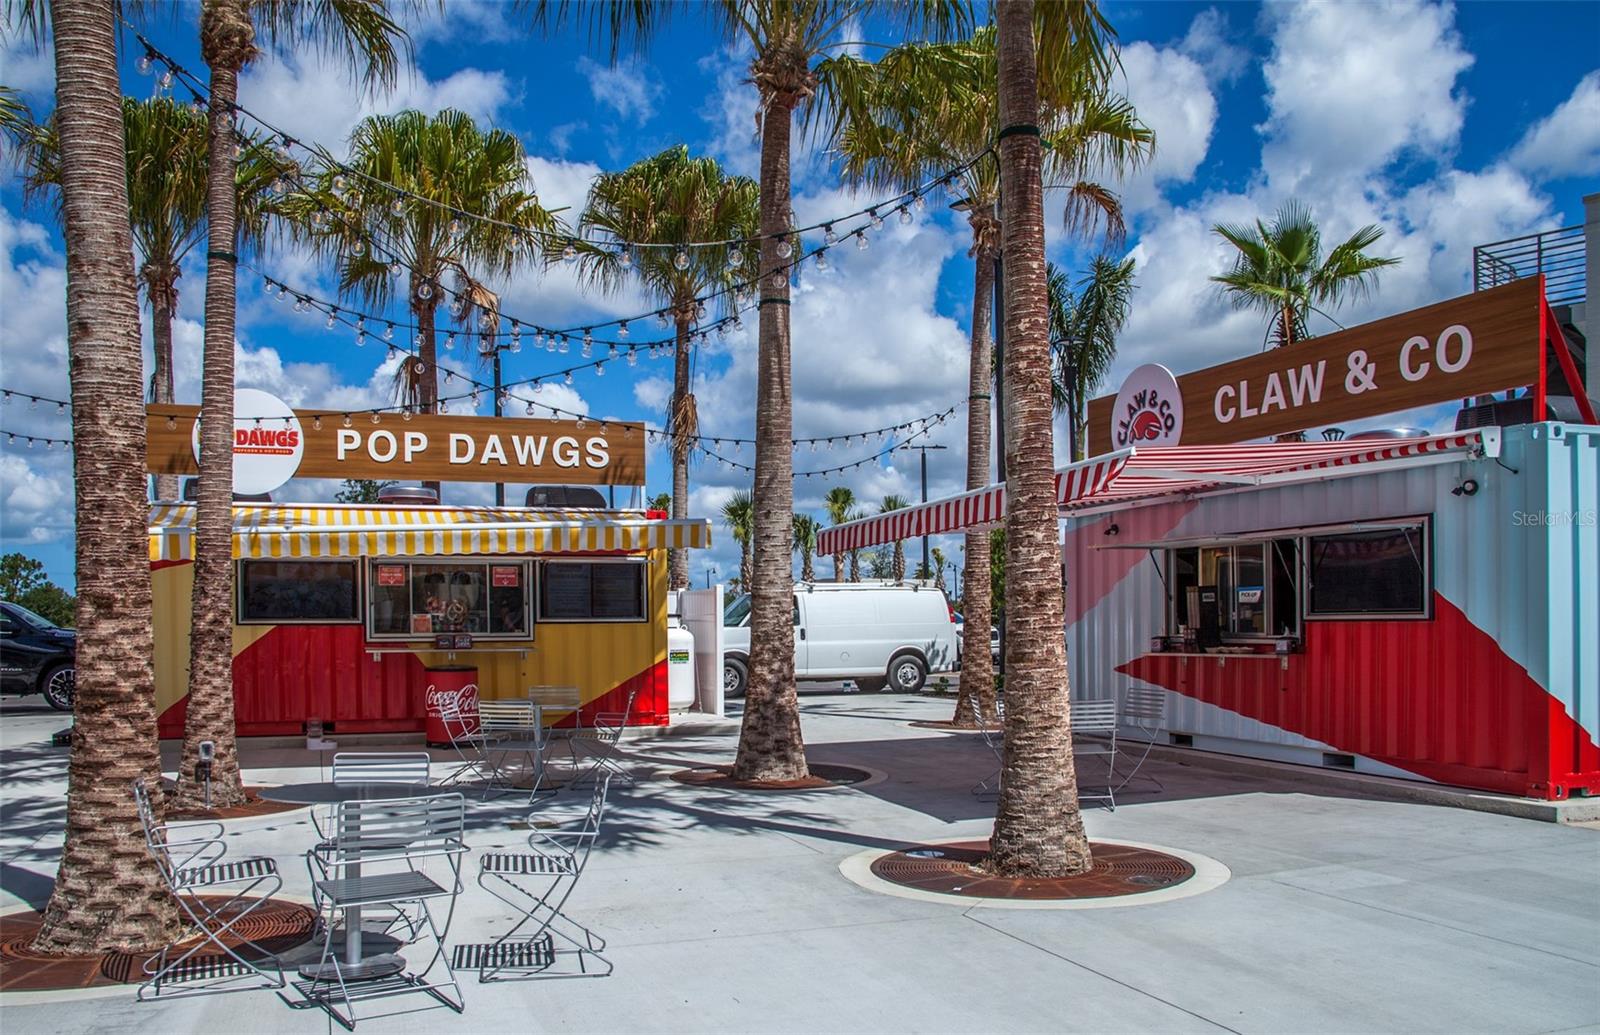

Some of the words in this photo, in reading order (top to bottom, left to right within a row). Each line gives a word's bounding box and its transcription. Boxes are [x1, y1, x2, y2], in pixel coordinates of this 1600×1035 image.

[1214, 360, 1326, 423] CLAW
[1345, 350, 1378, 394] &
[1399, 324, 1473, 381] CO
[236, 429, 299, 447] DAWGS
[336, 429, 428, 463] POP
[449, 433, 610, 468] DAWGS
[425, 684, 480, 711] CocCol
